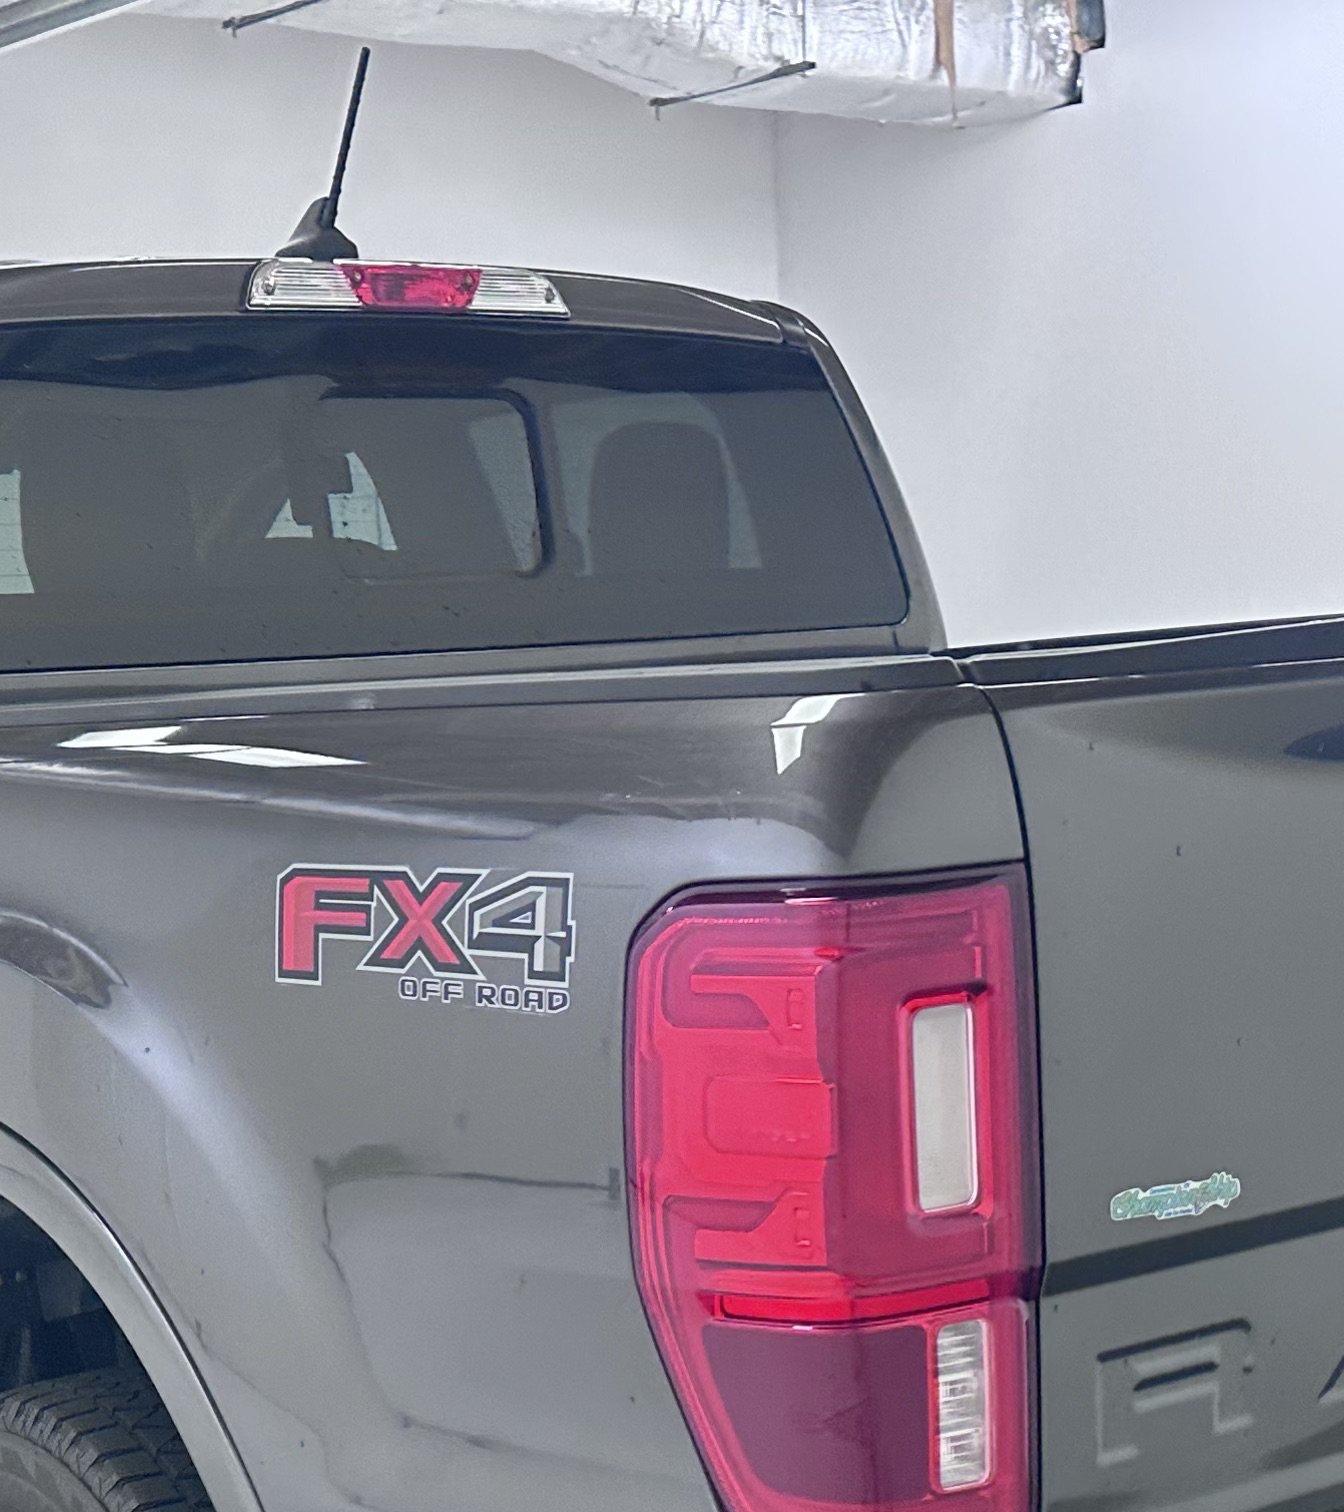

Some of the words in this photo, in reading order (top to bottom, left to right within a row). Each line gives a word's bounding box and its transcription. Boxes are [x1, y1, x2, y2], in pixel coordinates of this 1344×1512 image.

[275, 863, 576, 988] FX4
[399, 976, 464, 1004] OFF
[475, 981, 571, 1014] ROAD
